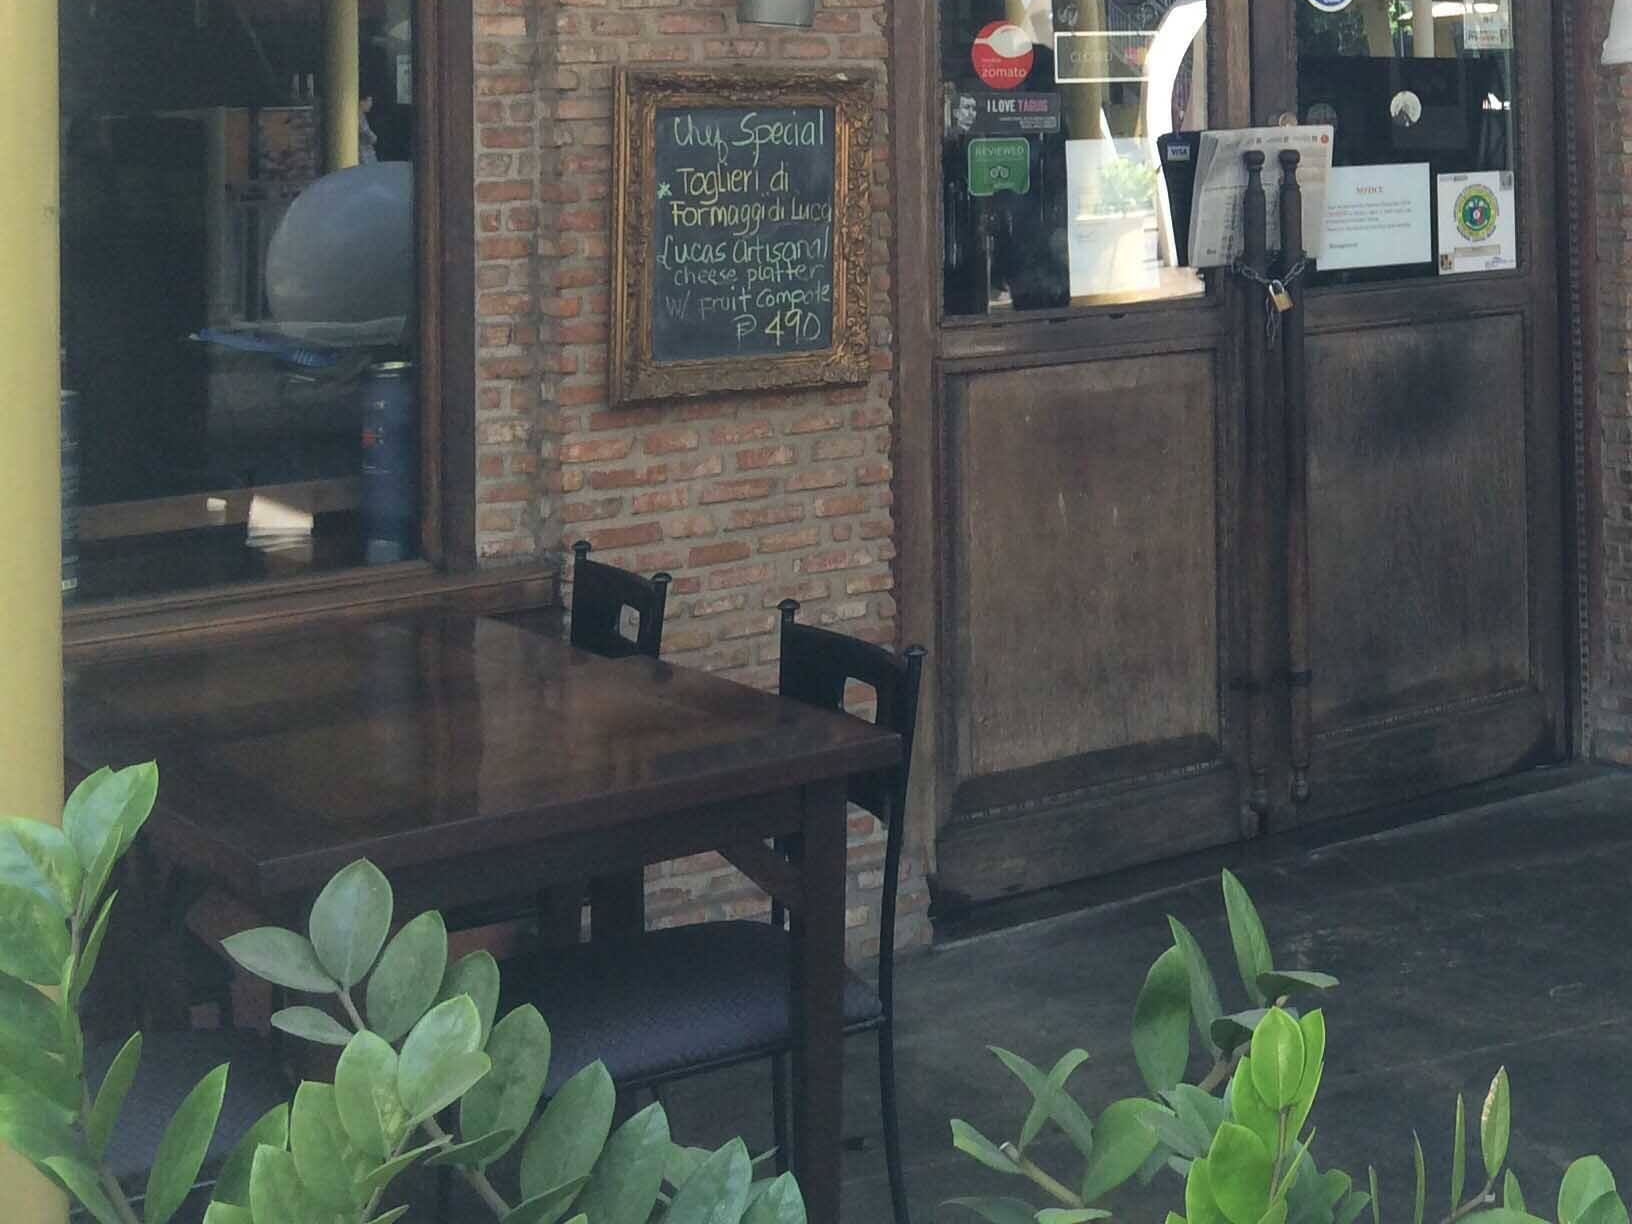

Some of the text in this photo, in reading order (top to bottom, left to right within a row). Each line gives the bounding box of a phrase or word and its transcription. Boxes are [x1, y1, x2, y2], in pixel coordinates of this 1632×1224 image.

[982, 66, 1027, 77] zomato
[992, 99, 1016, 112] LOVE
[732, 109, 824, 167] Special
[770, 160, 790, 192] di
[670, 200, 765, 236] Formaggi
[768, 197, 785, 221] di
[656, 235, 727, 270] Lucas
[748, 260, 824, 291] platter
[764, 309, 820, 346] 490
